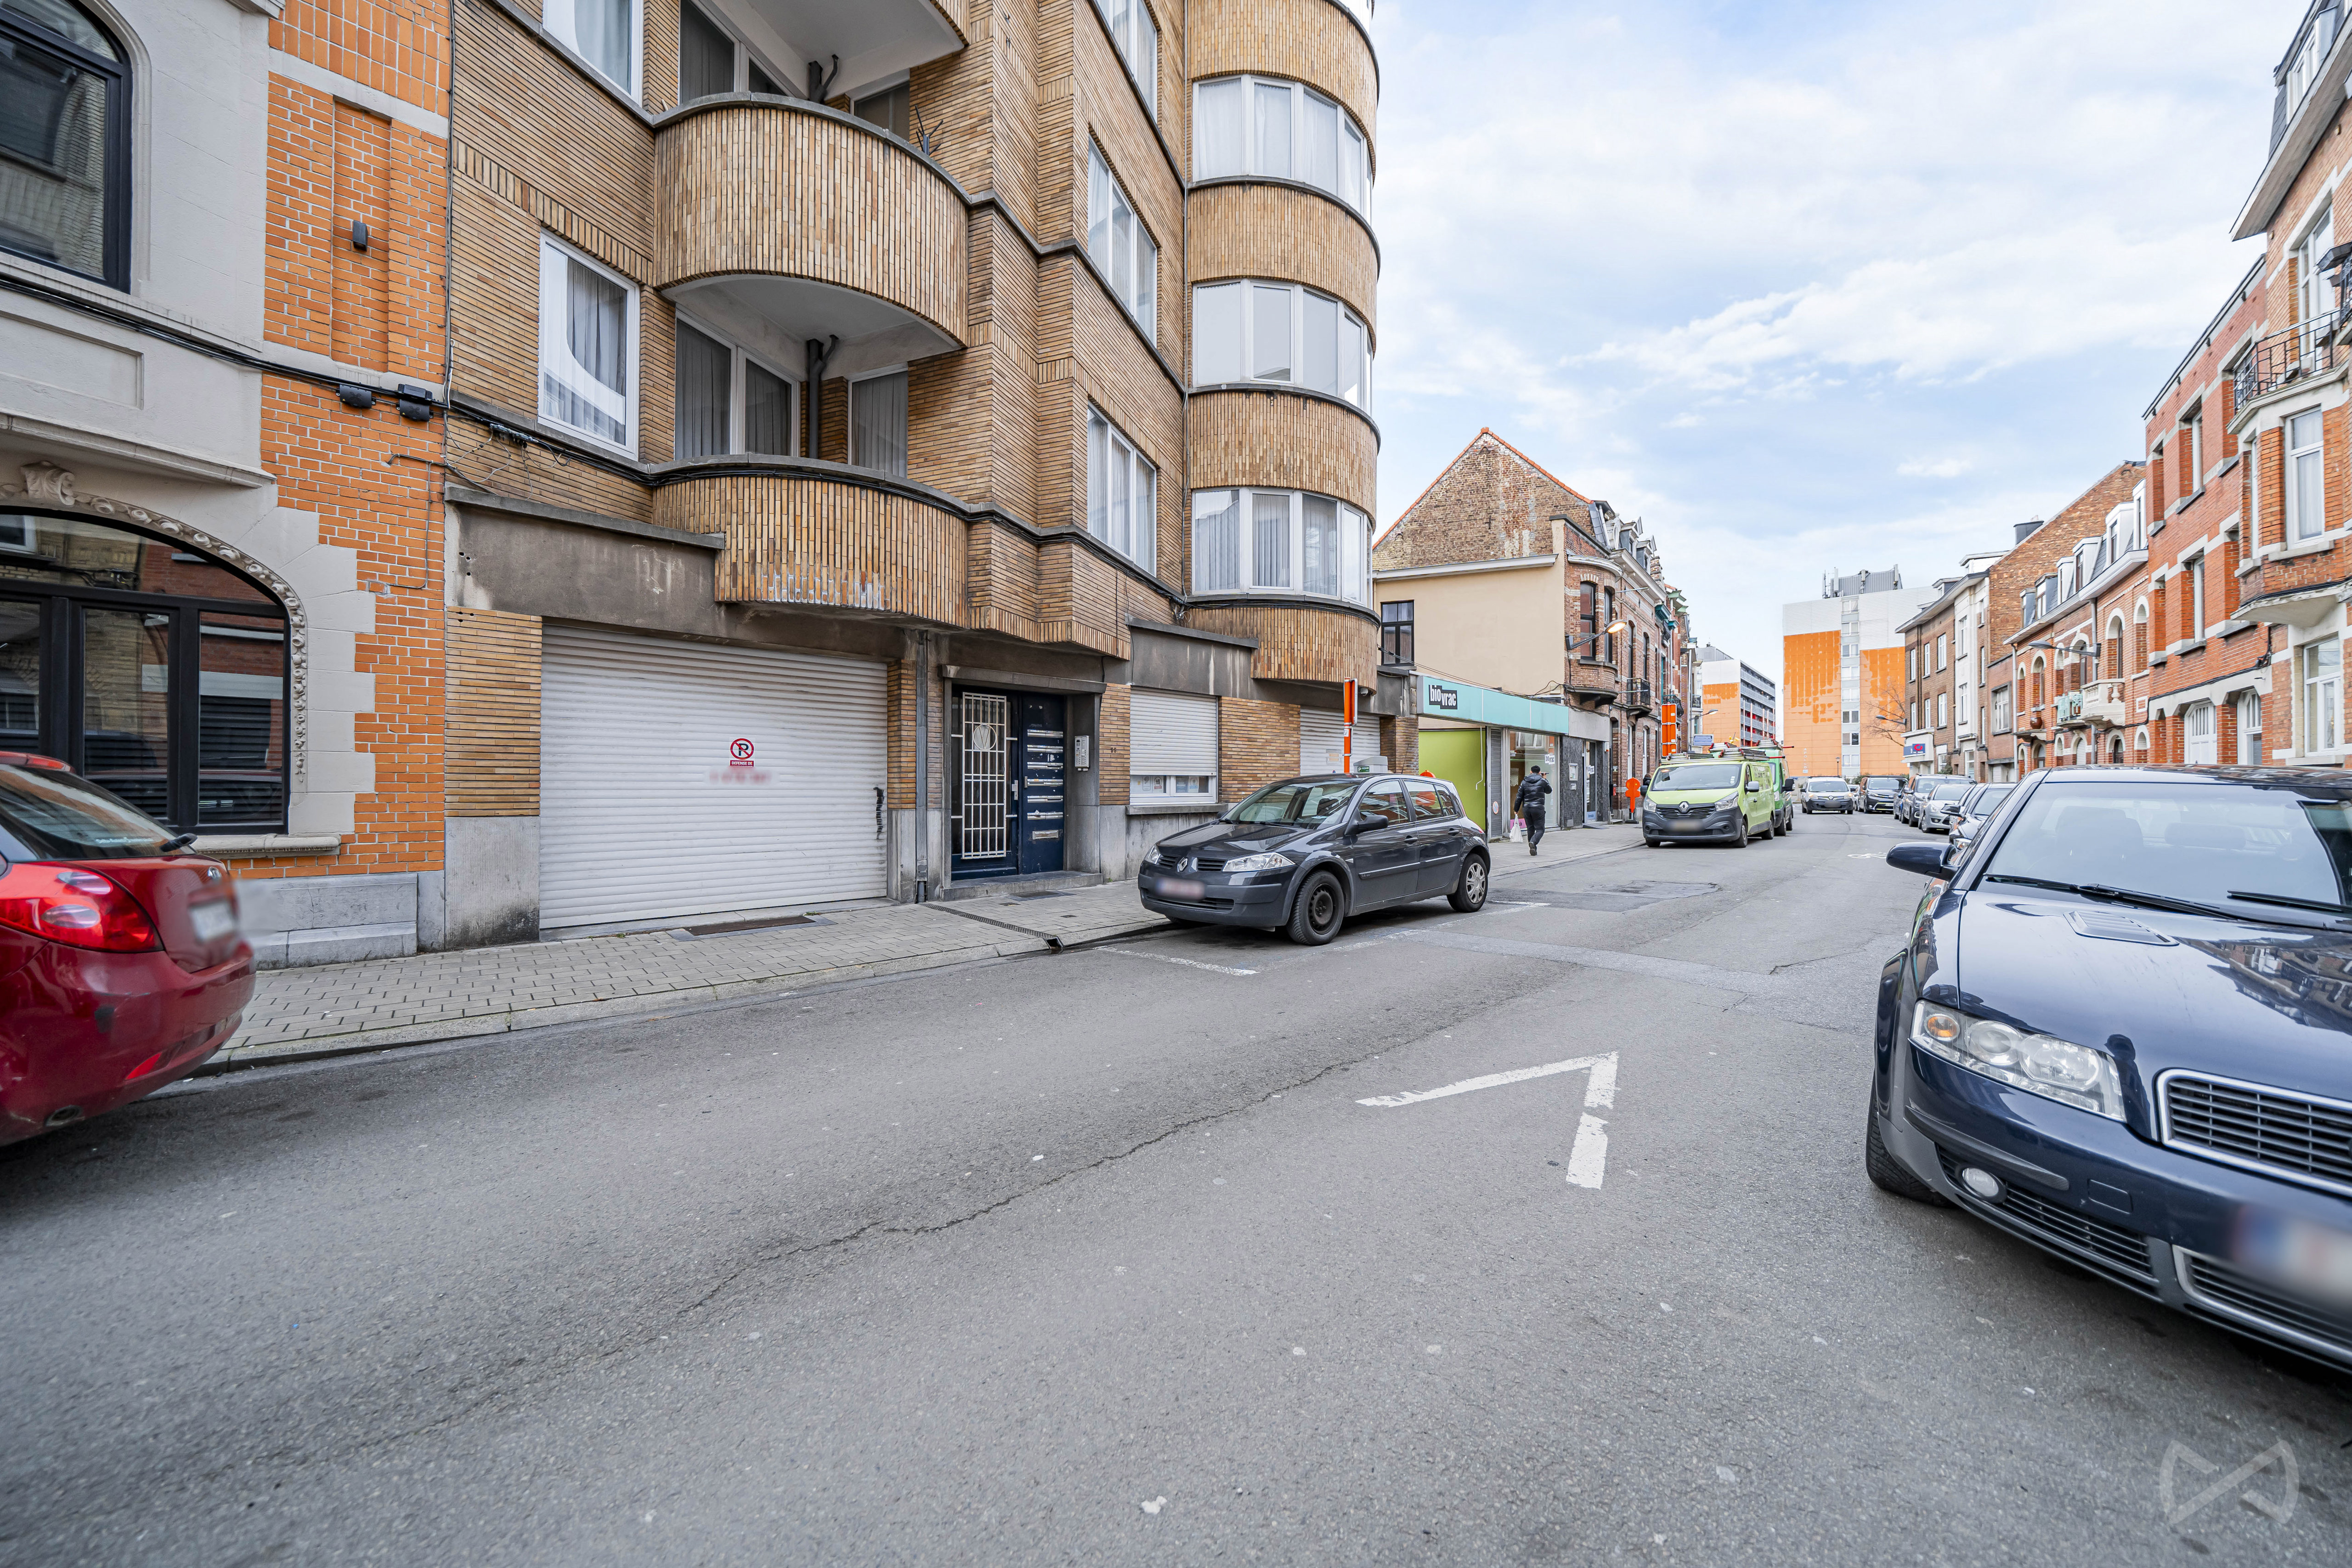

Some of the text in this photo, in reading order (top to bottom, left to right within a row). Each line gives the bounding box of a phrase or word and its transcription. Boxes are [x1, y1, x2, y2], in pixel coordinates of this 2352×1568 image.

[1430, 685, 1456, 706] bio vrac
[739, 743, 749, 756] P
